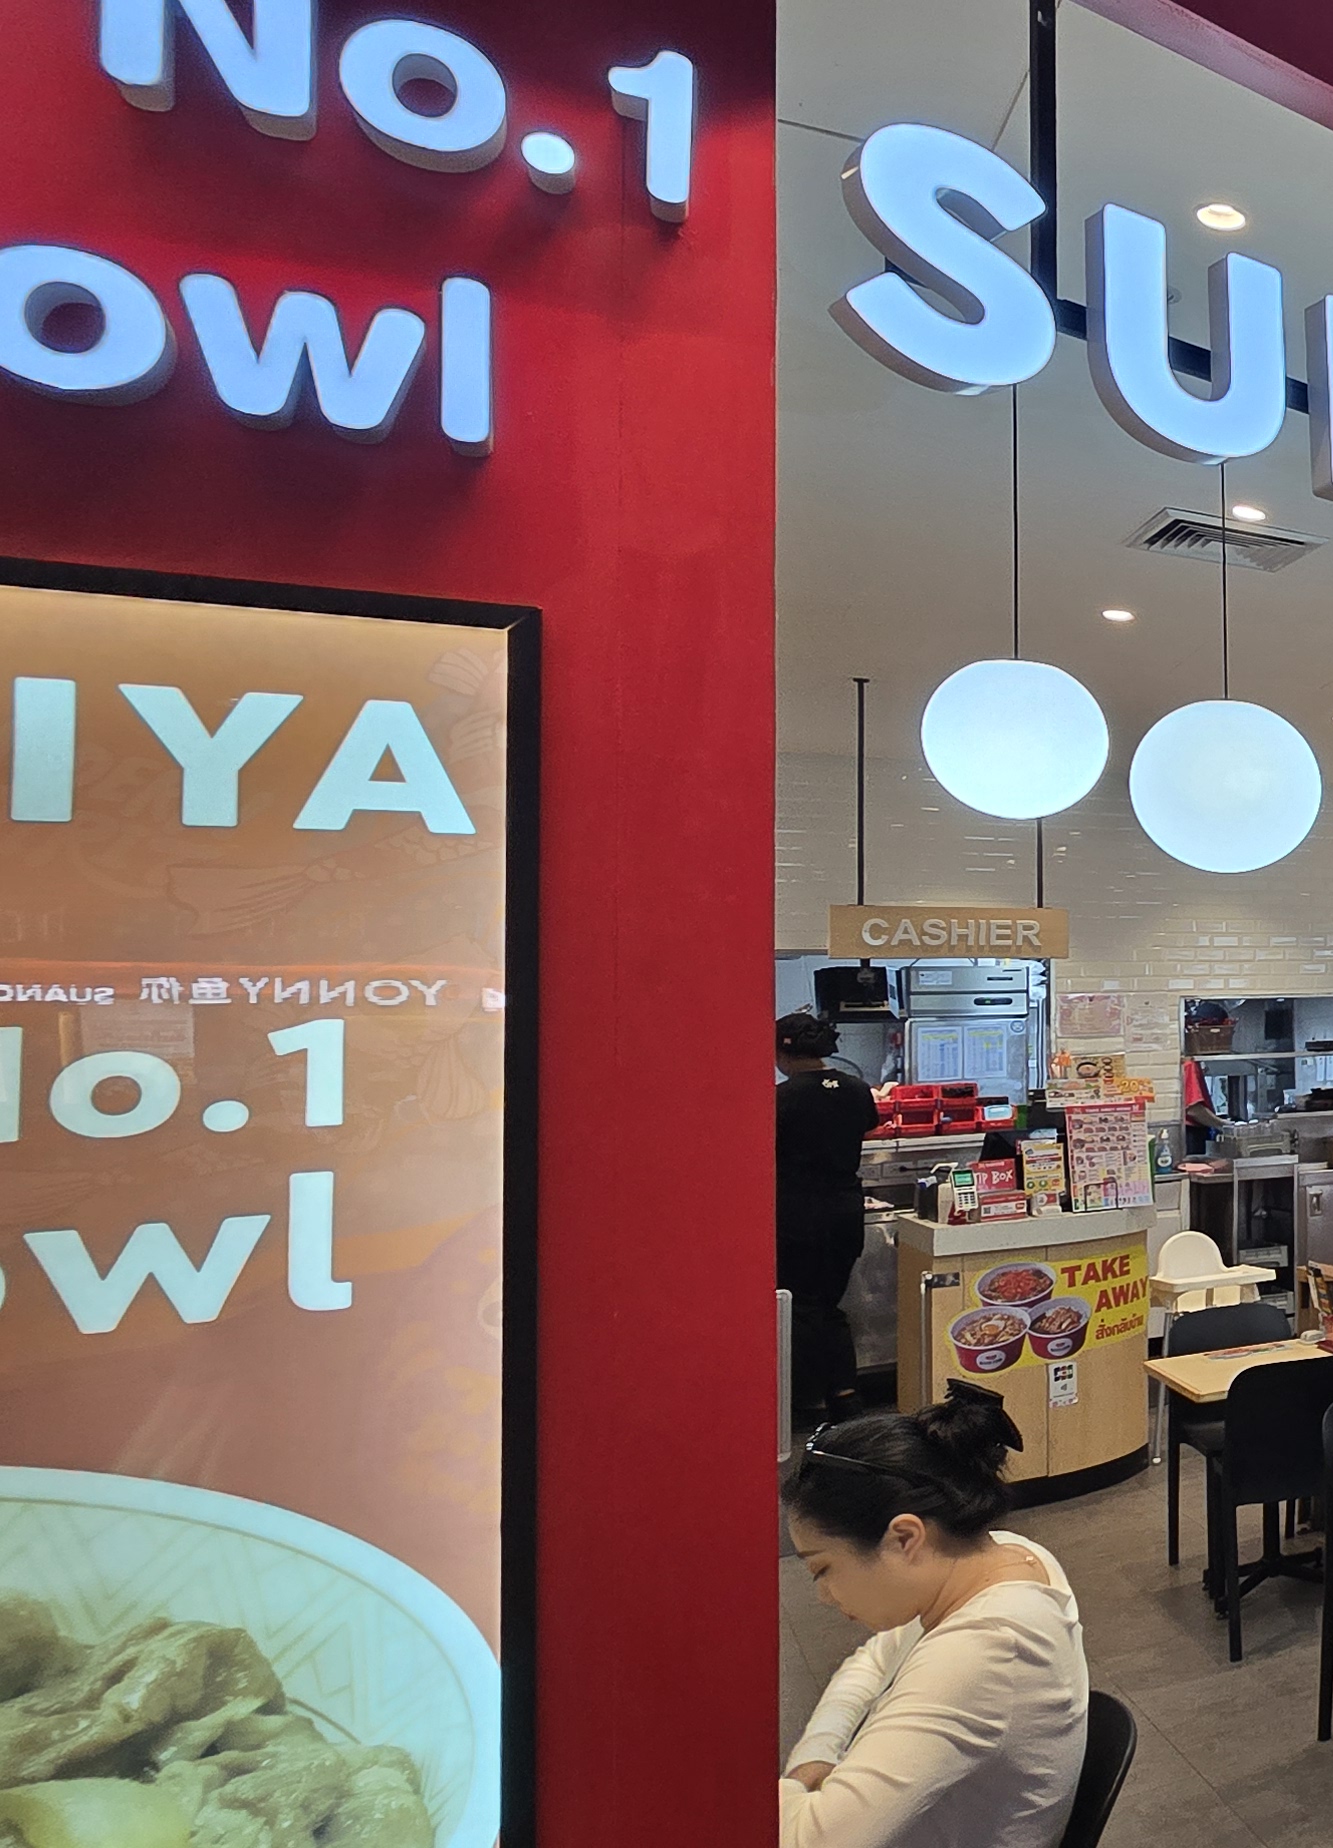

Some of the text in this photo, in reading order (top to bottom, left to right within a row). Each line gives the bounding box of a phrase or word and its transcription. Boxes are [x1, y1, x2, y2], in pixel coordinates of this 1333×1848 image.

[861, 917, 1043, 948] CASHIER
[991, 1169, 1014, 1185] BOX
[0, 1171, 353, 1336] wl
[1060, 1253, 1131, 1289] TAKE
[1094, 1276, 1149, 1314] AWAY
